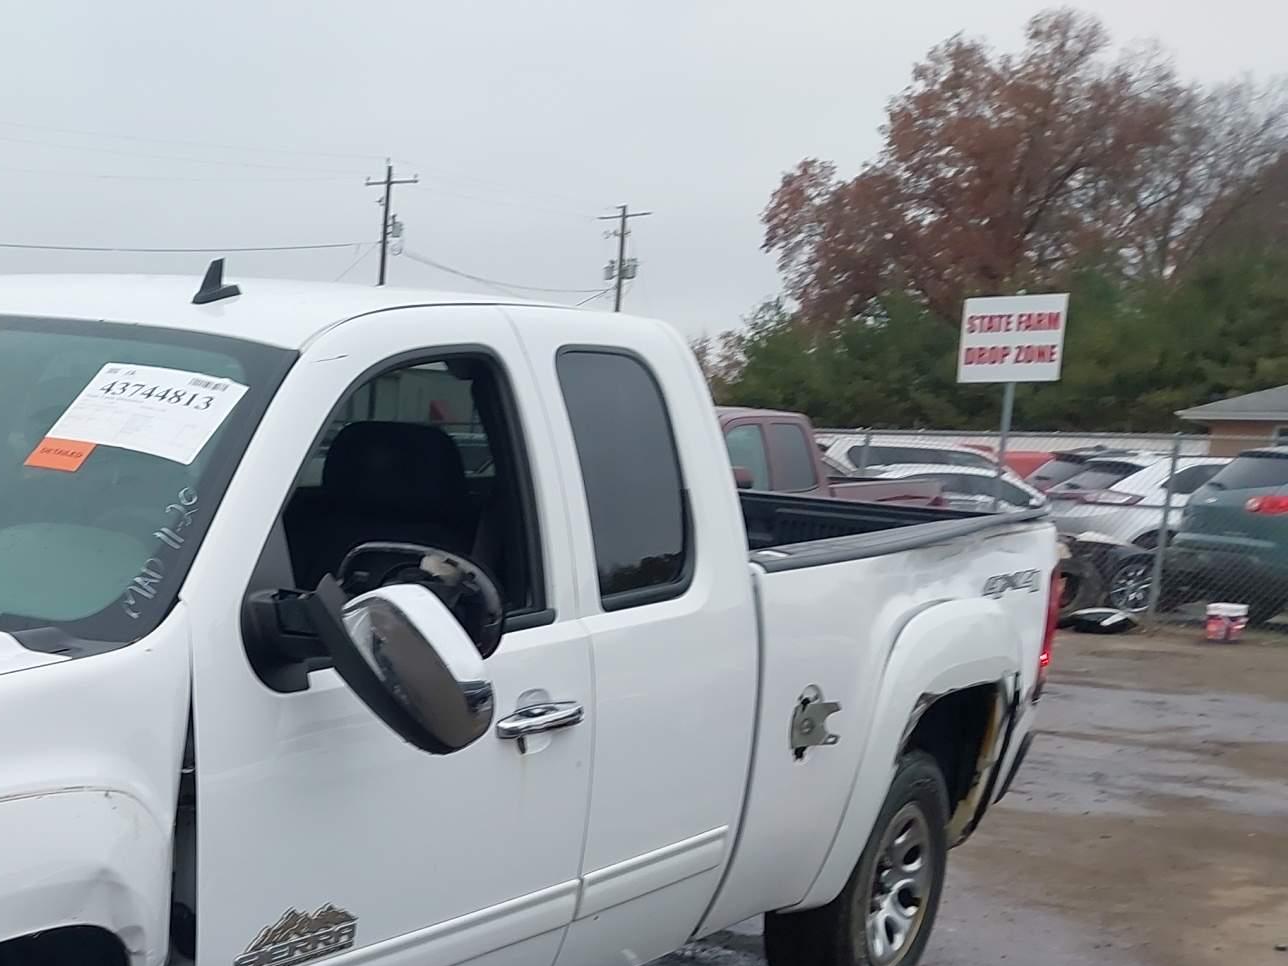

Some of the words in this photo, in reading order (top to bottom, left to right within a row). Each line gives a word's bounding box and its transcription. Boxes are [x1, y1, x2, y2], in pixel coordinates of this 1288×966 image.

[966, 314, 1013, 333] STATE
[1015, 312, 1060, 331] FARM
[964, 346, 1010, 365] DROP
[1013, 345, 1057, 364] ZONE
[100, 381, 214, 410] 43744813
